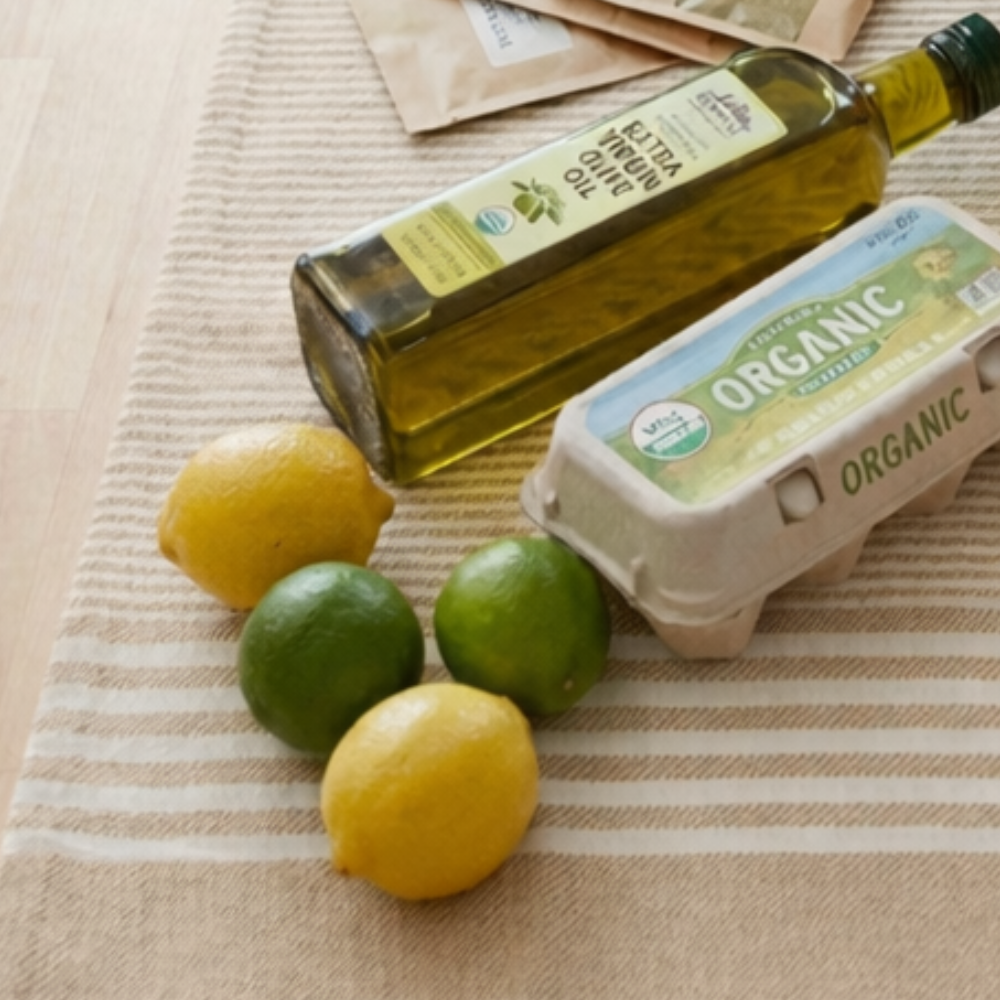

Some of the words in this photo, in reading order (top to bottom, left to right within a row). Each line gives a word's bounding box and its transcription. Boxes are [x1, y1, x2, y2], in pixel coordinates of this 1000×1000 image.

[564, 168, 597, 199] OIL
[710, 284, 905, 413] ORGANIC
[840, 386, 971, 496] ORGANIC
